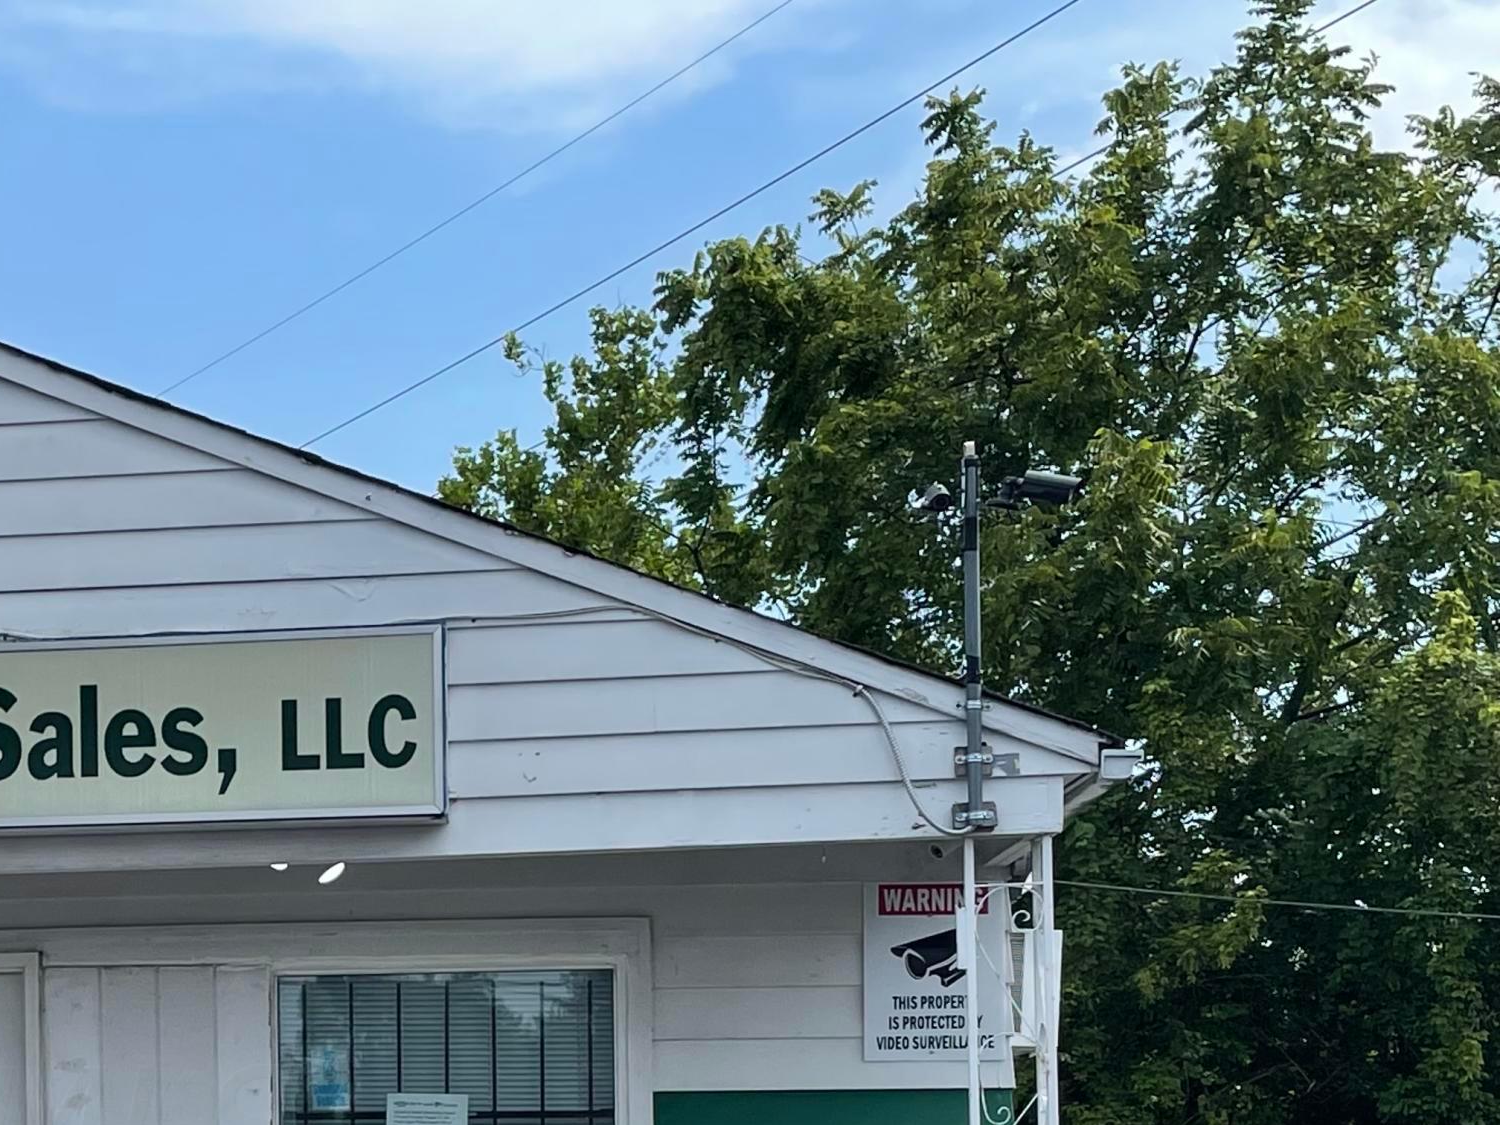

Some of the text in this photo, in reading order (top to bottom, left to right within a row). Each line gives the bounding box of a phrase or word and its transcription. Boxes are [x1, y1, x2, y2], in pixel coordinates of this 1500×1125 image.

[281, 693, 418, 772] LLC
[892, 994, 968, 1010] THIS PROPER
[888, 1016, 900, 1030] IS
[902, 1014, 966, 1030] PROTECTED
[876, 1034, 995, 1050] VIDEO SURVEILLCE
